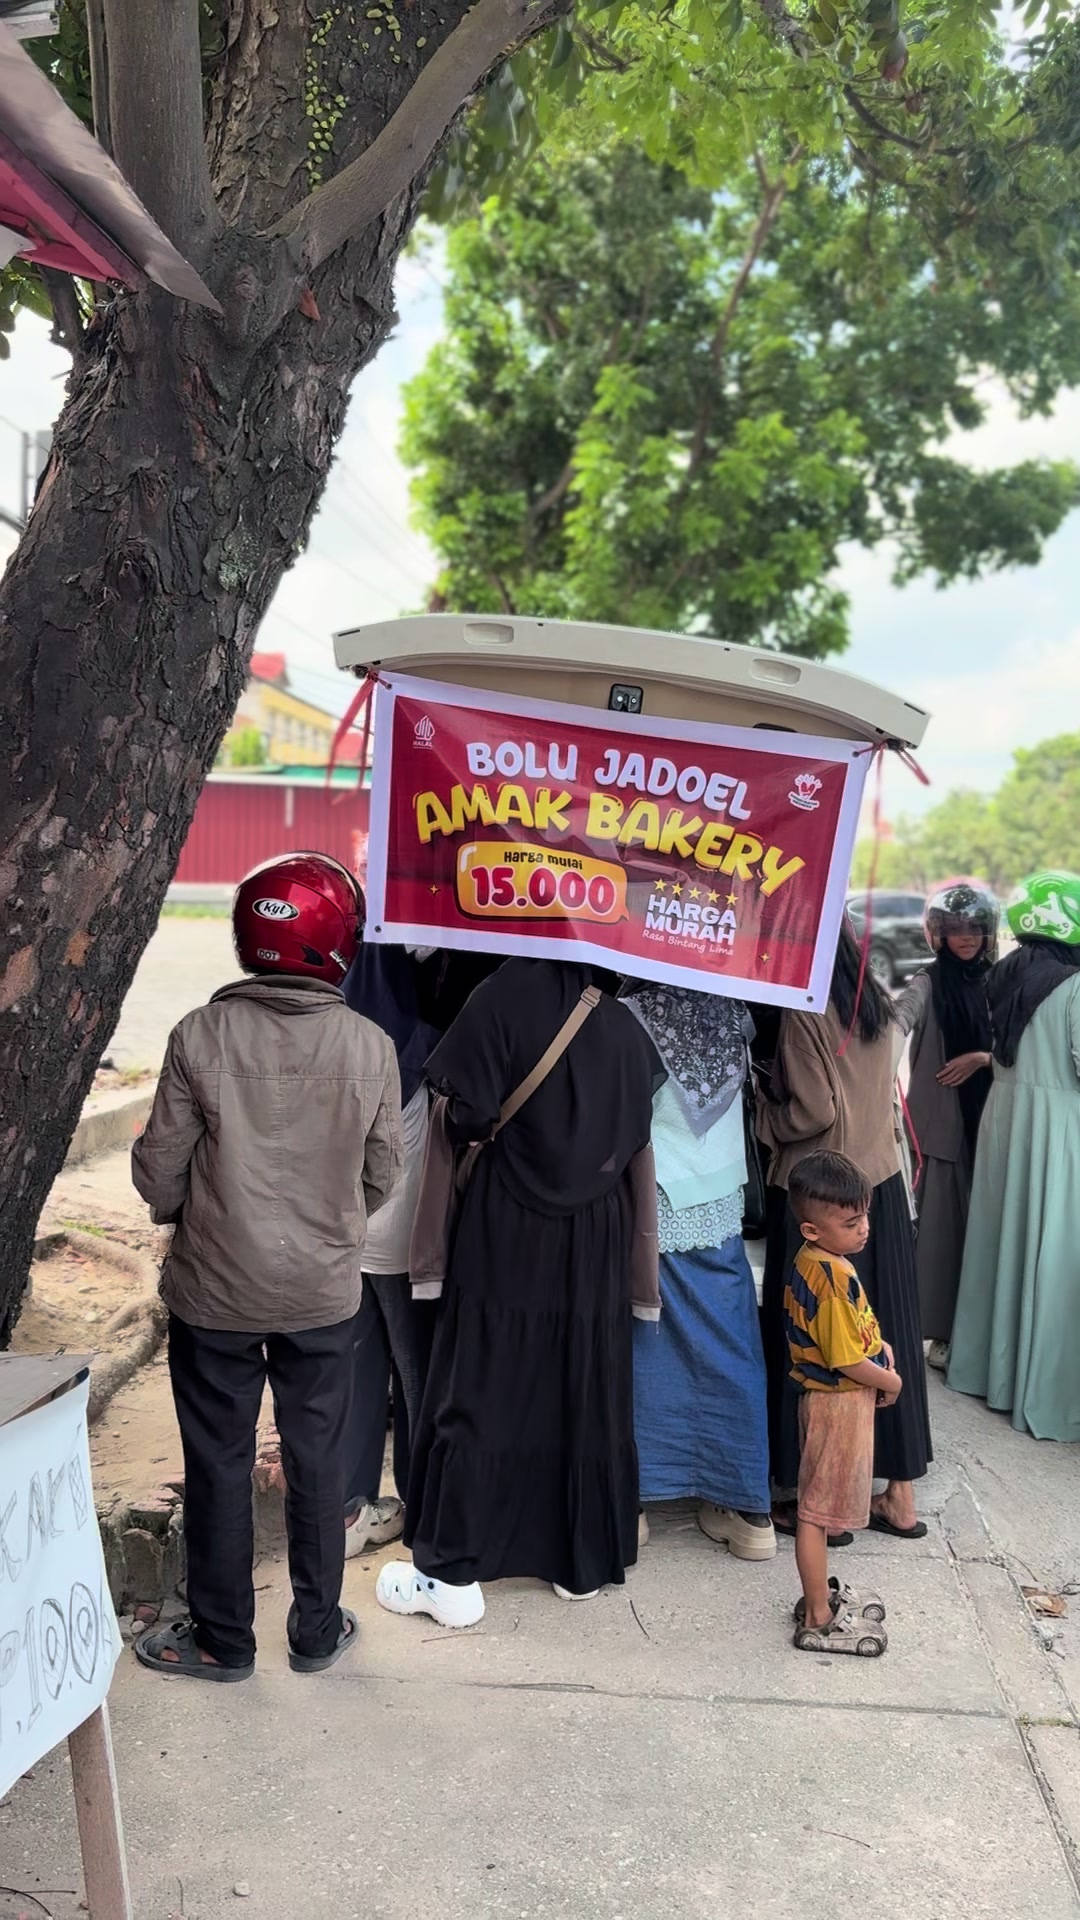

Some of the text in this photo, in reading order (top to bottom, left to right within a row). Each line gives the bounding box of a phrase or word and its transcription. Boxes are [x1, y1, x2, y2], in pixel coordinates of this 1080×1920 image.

[466, 741, 752, 821] BOLU JADOEL
[416, 782, 806, 897] AMAK BAKERY
[504, 851, 583, 870] Harga mulai
[470, 864, 617, 917] 15.000
[645, 911, 736, 946] MURAH
[647, 893, 737, 929] HARGA
[259, 949, 277, 960] DOT
[642, 929, 734, 956] Rasa Bintang Lima
